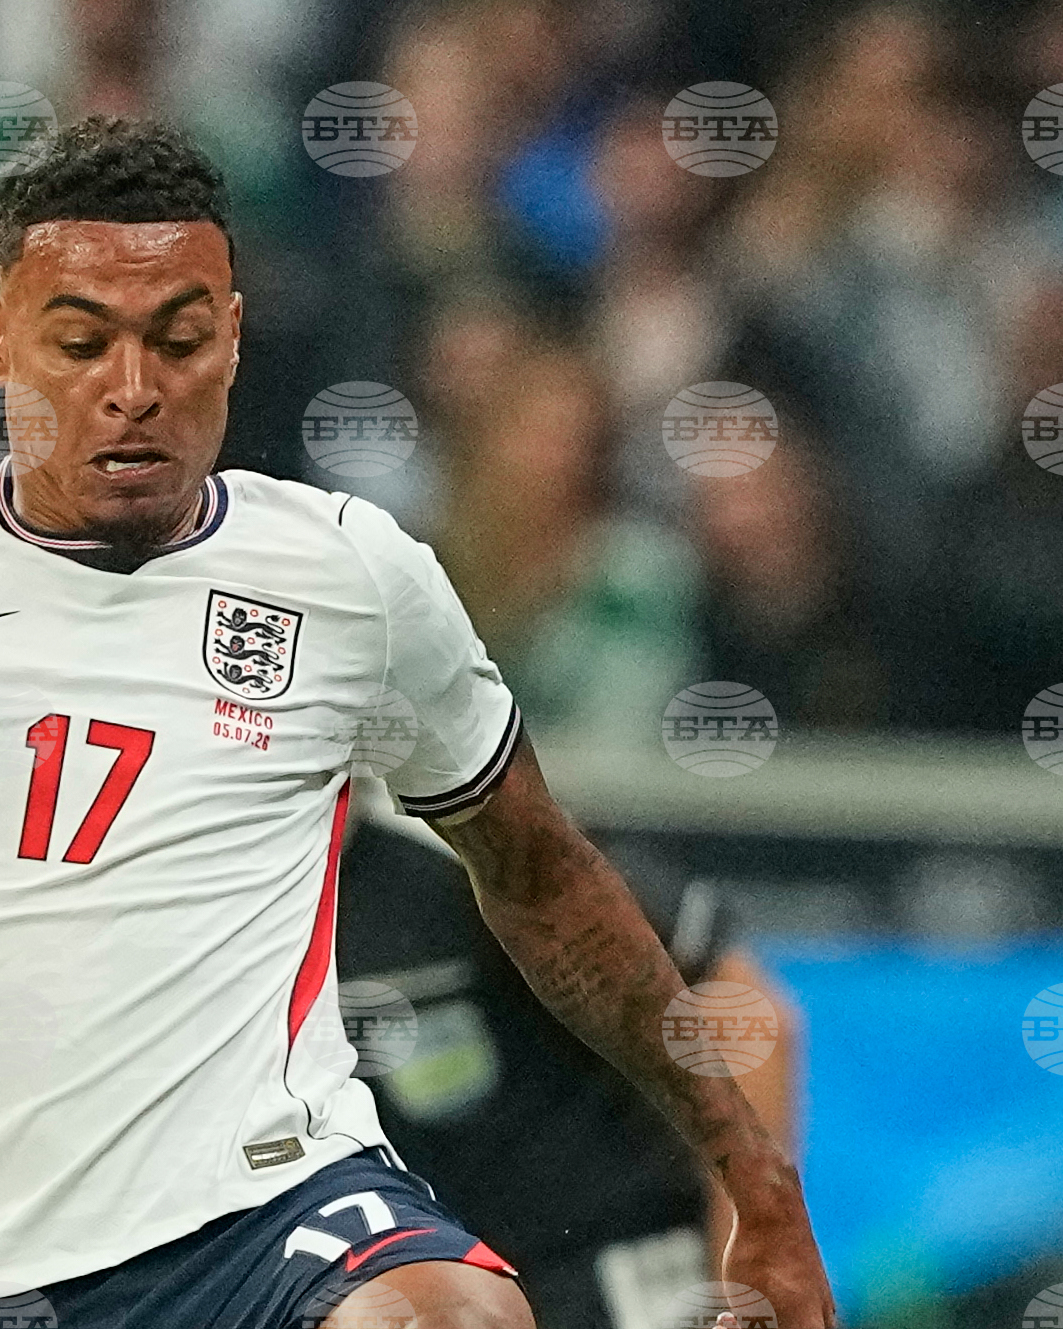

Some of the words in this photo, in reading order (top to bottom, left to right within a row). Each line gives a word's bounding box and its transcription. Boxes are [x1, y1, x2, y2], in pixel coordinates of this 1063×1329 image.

[213, 721, 271, 751] 05.07.26
[214, 698, 273, 730] MEXICO
[17, 713, 156, 865] 17
[284, 1190, 399, 1263] 17
